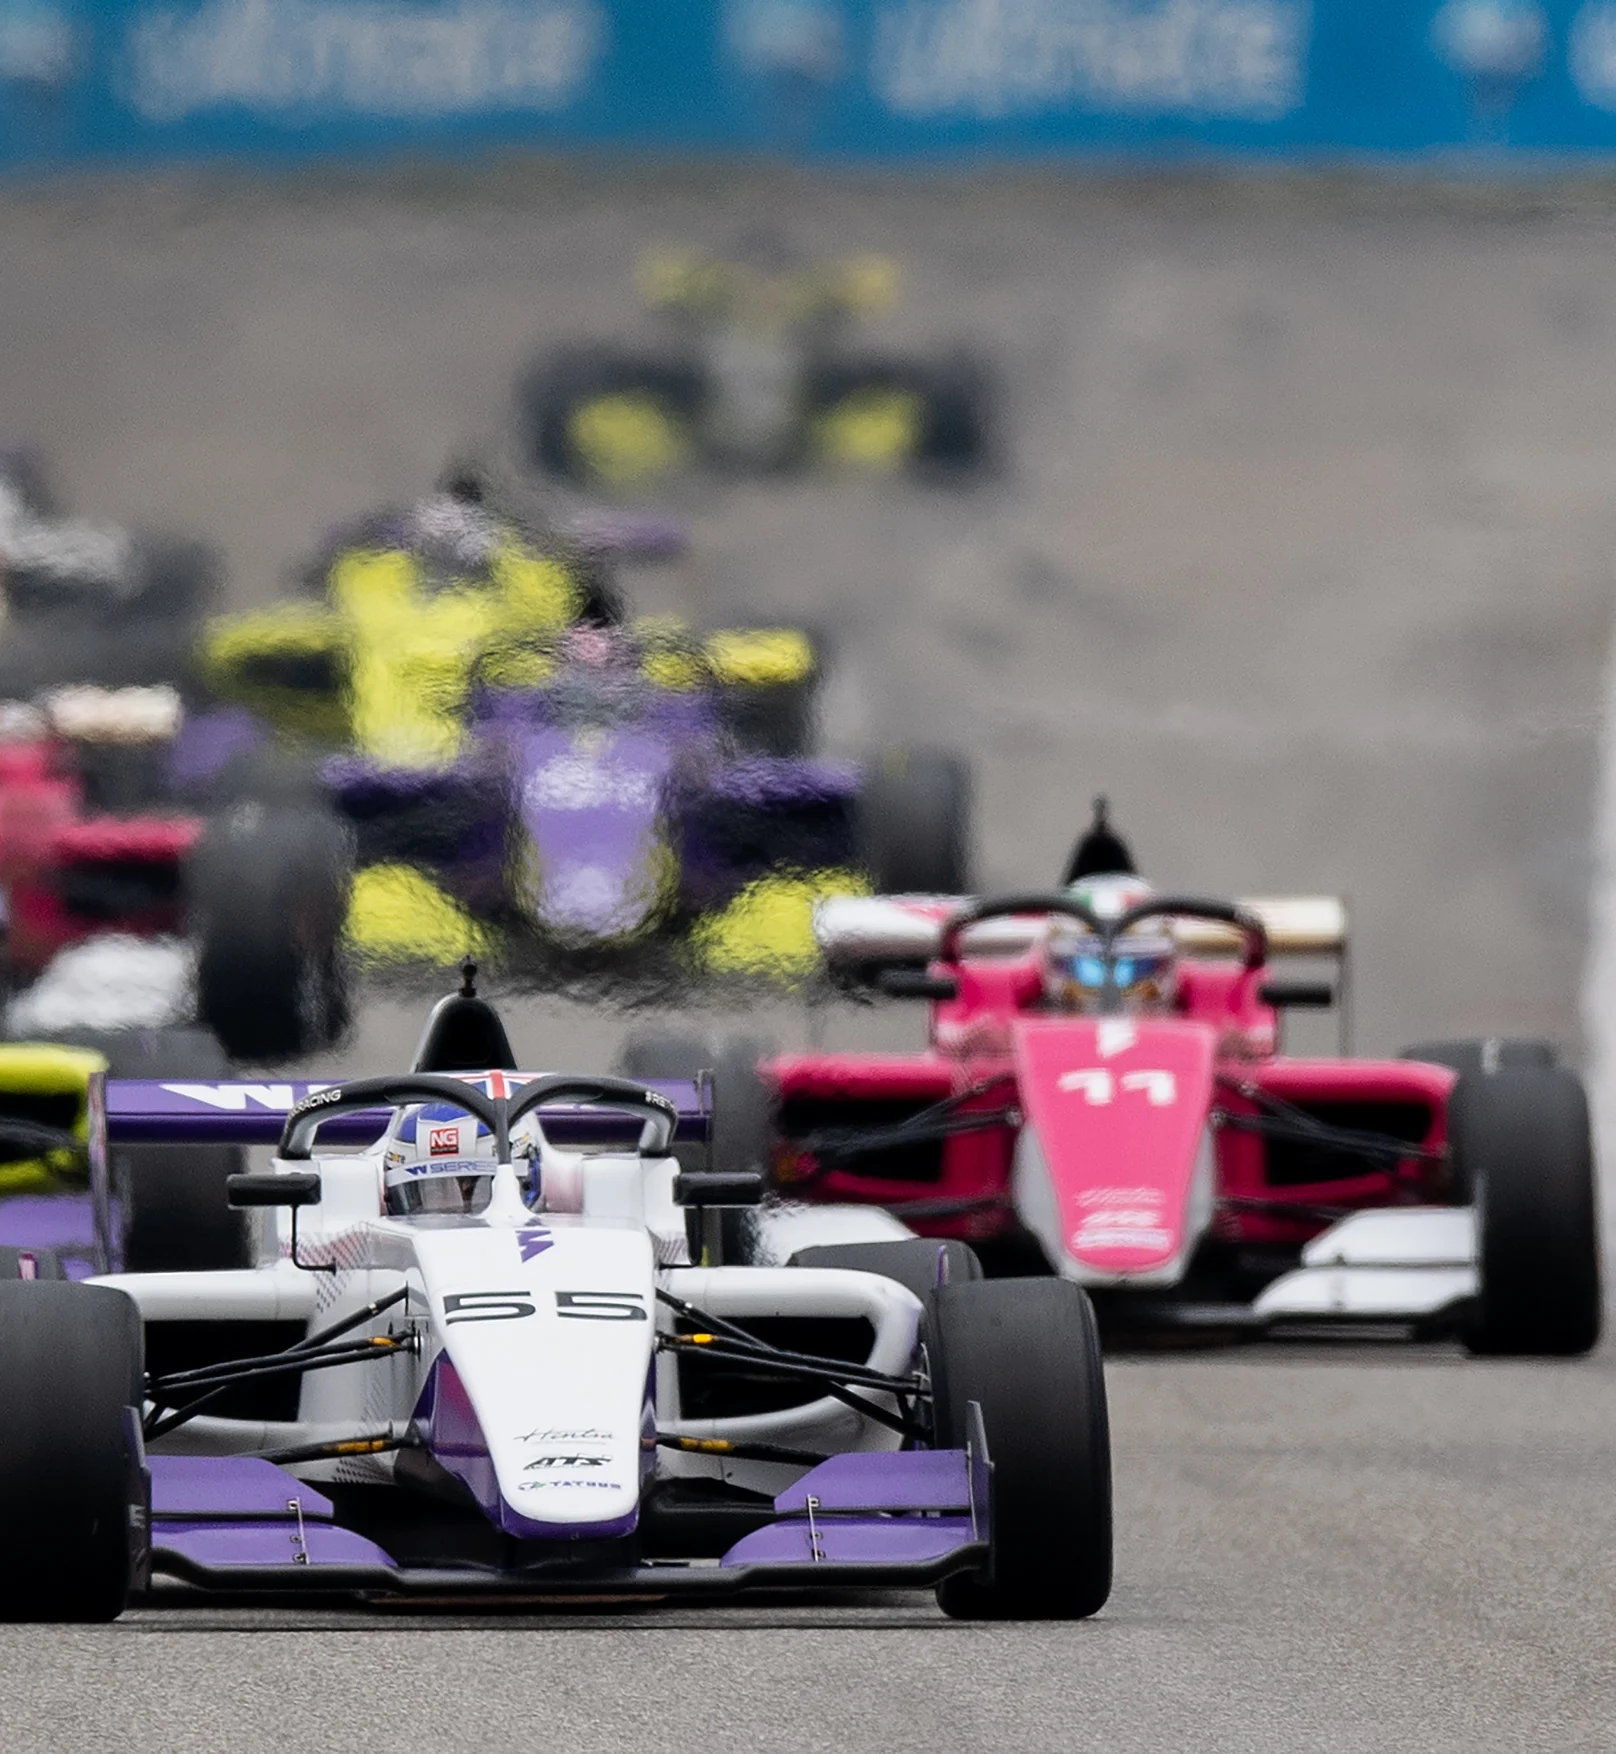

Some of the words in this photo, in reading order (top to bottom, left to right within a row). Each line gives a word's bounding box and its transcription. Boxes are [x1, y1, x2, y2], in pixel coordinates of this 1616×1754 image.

[1058, 1068, 1176, 1107] 11
[431, 1130, 457, 1147] NG
[443, 1291, 648, 1326] 55
